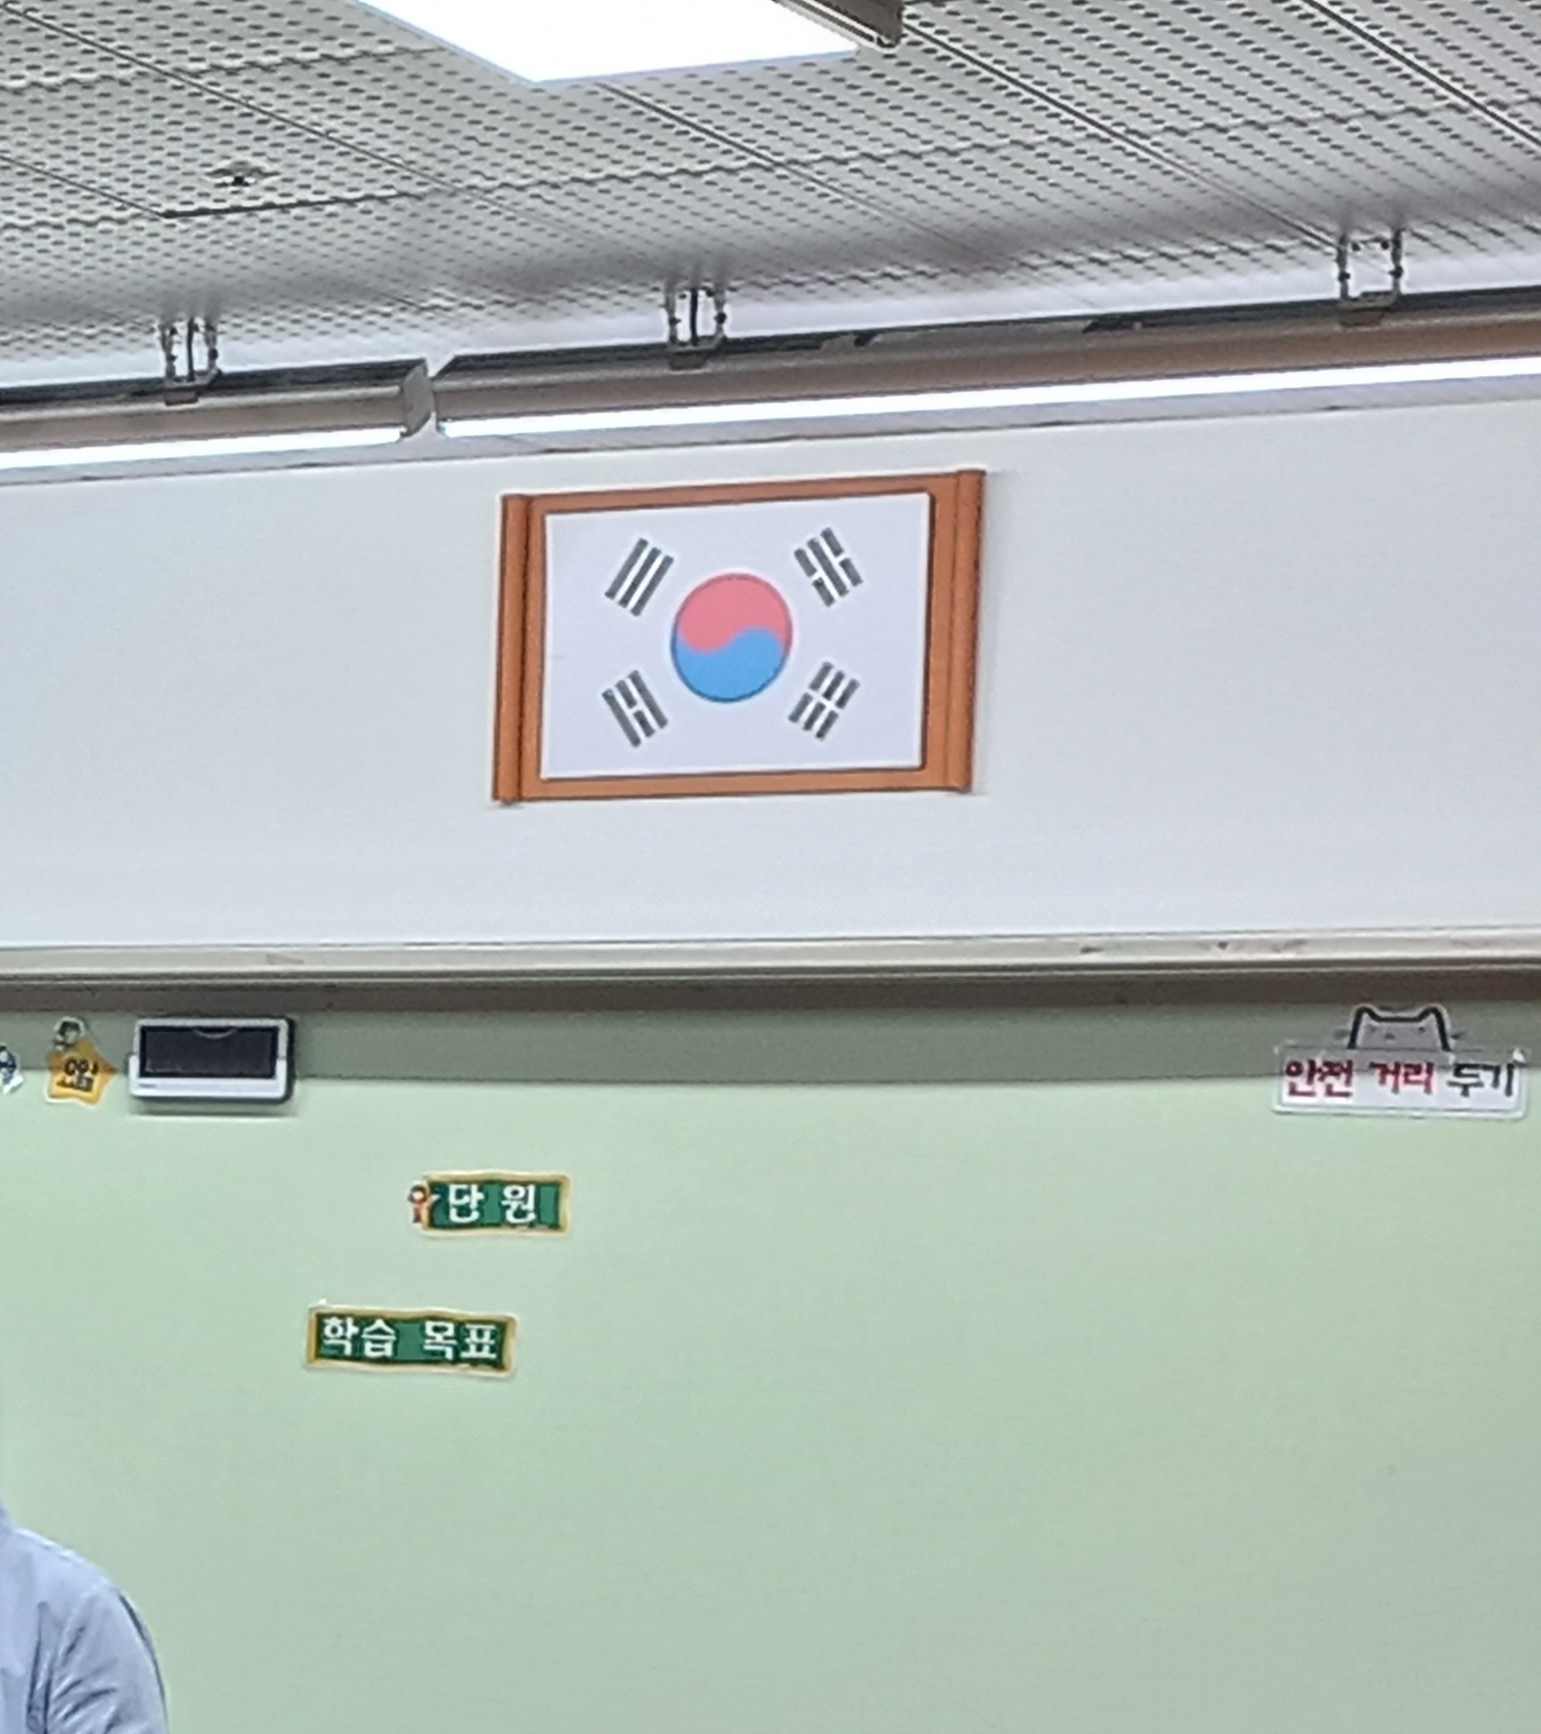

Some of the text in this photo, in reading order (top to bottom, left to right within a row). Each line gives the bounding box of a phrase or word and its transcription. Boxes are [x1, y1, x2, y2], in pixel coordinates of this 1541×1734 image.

[1284, 1058, 1515, 1098] 안전 거리 두기
[322, 1316, 499, 1361] 학습 목표
